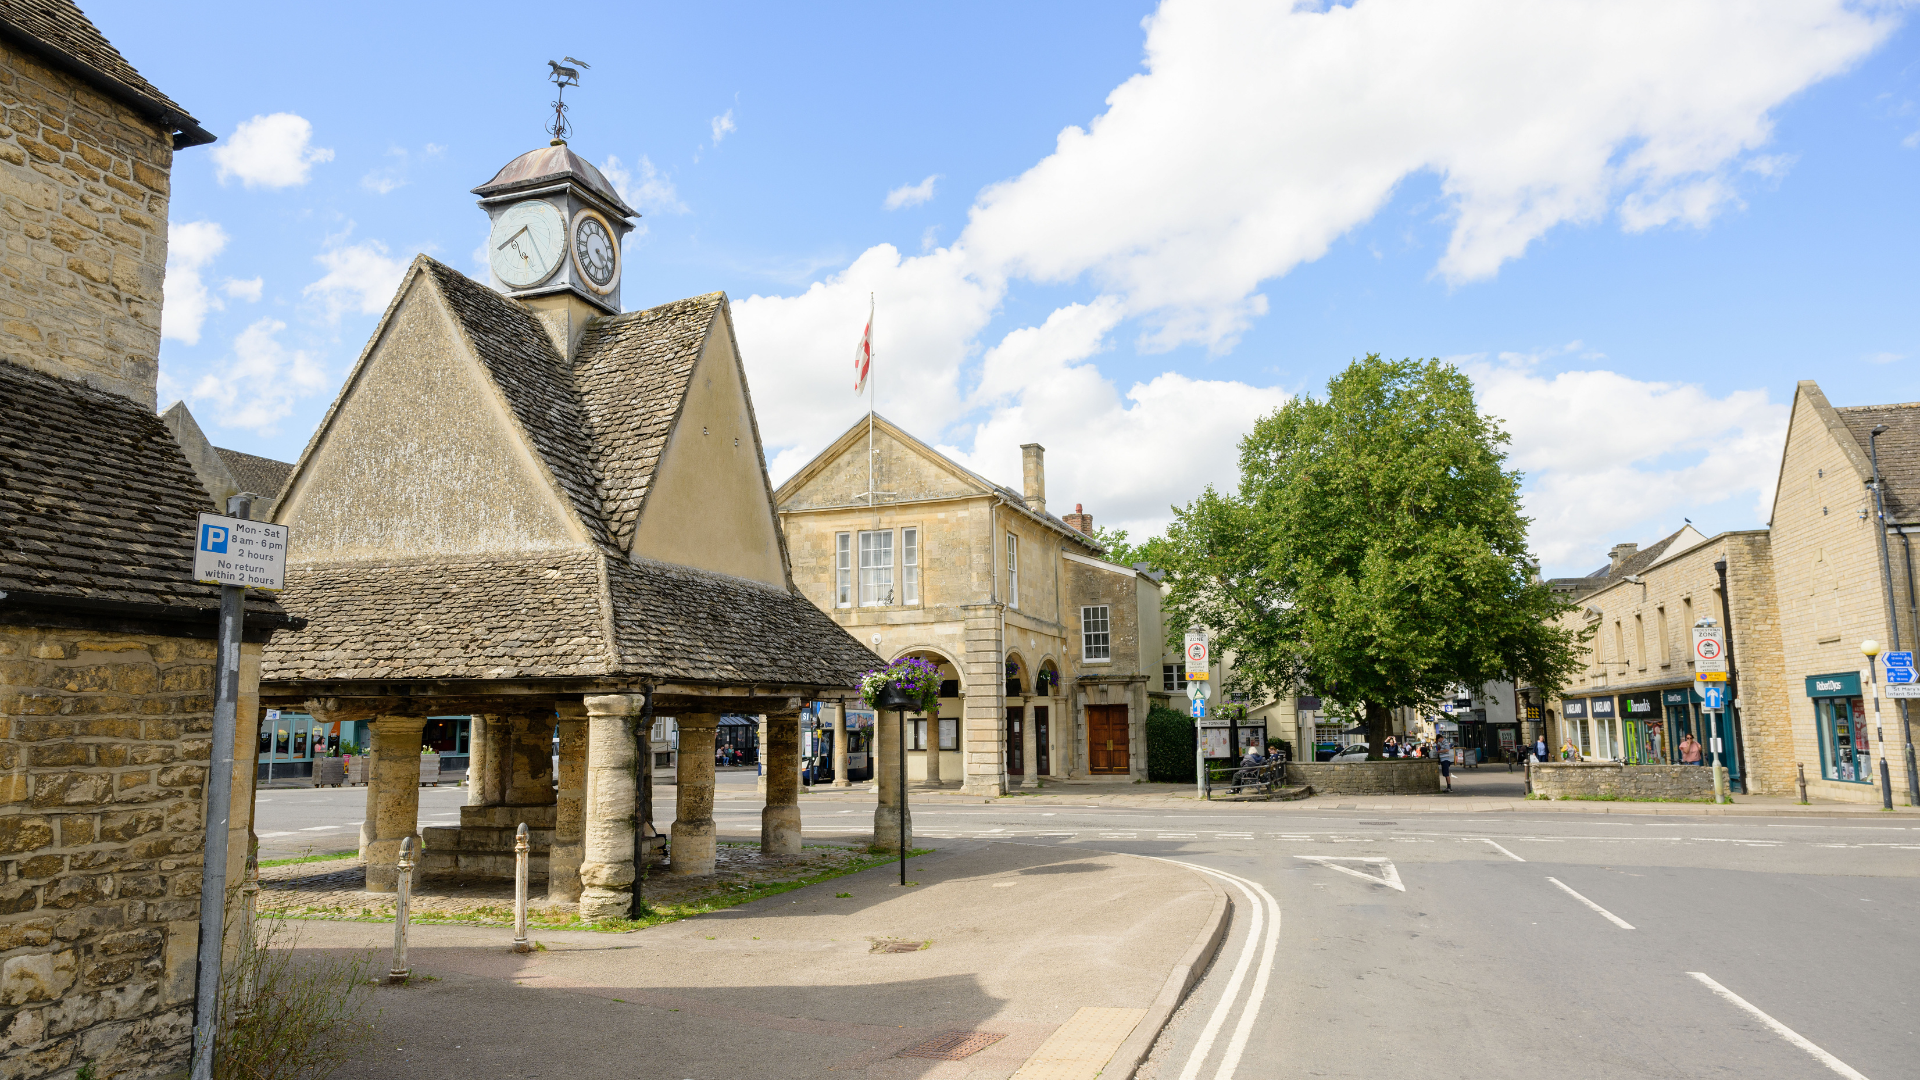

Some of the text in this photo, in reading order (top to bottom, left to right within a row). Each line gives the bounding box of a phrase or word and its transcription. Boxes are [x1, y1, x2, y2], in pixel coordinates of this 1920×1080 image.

[236, 524, 256, 534] Mon
[264, 529, 280, 538] Sat
[207, 527, 225, 550] P
[238, 549, 274, 561] 2 hours
[218, 560, 264, 573] No return
[205, 570, 274, 584] within 2 hours
[1566, 704, 1581, 714] LAKELAND
[1593, 701, 1611, 712] LAKELAND
[1631, 698, 1650, 712] Barnardo's
